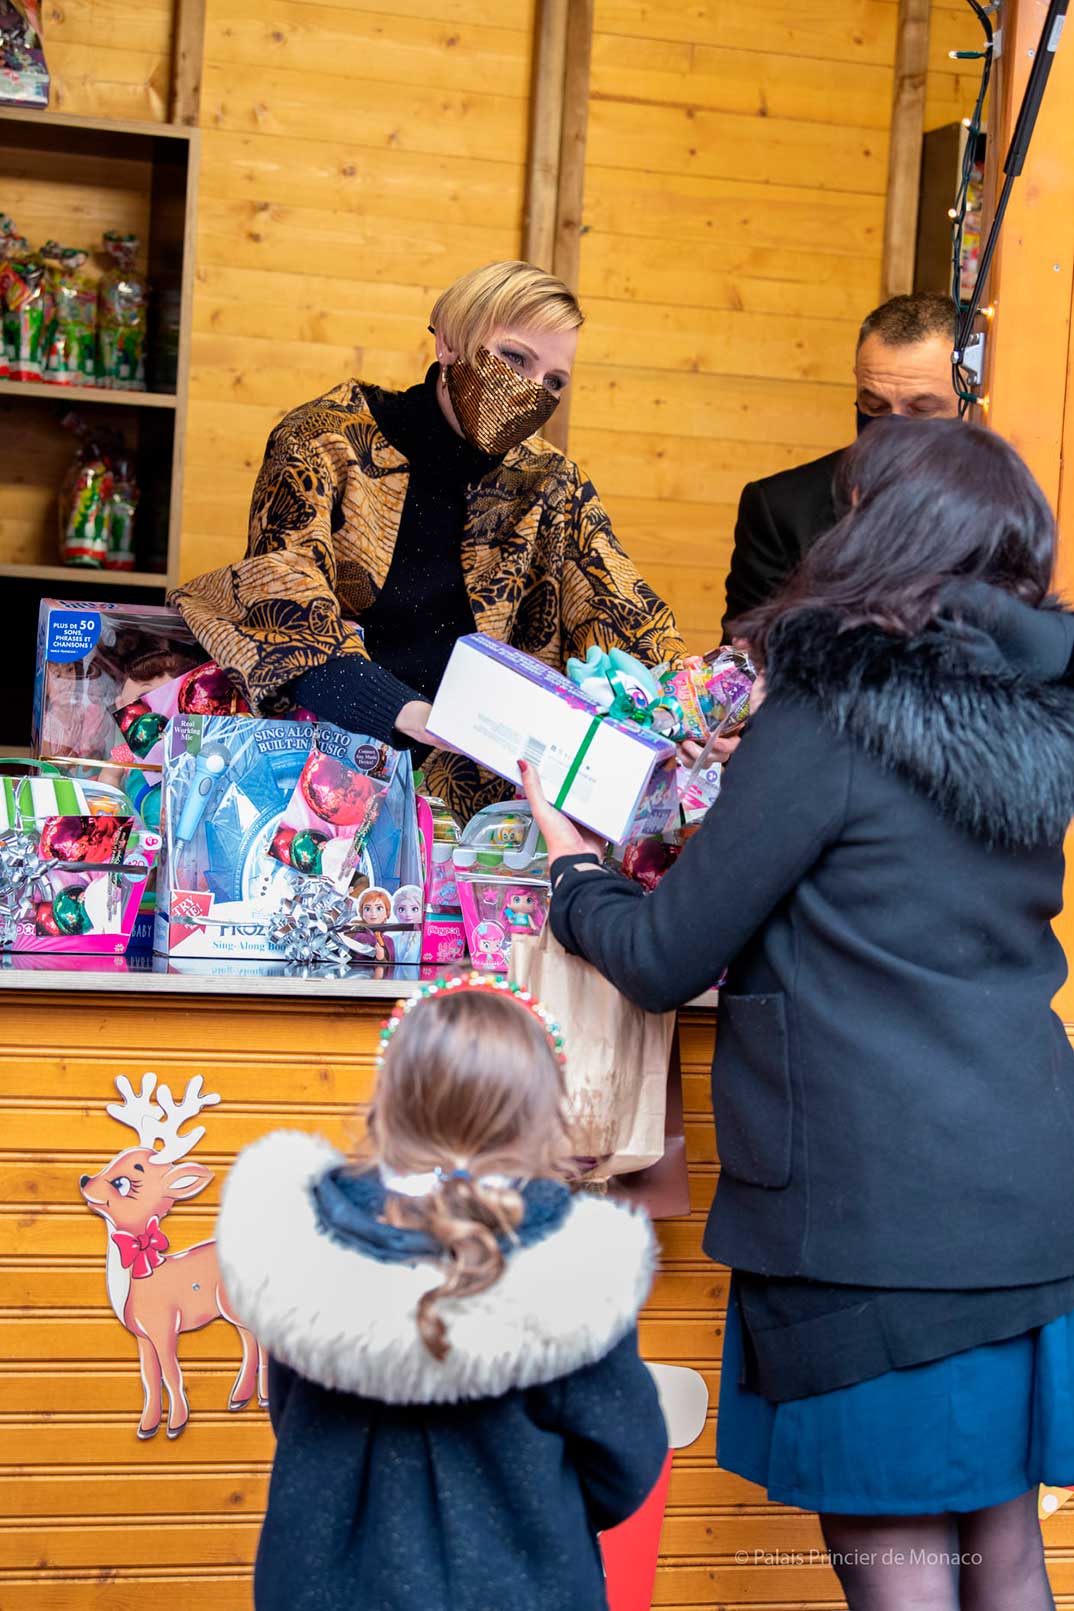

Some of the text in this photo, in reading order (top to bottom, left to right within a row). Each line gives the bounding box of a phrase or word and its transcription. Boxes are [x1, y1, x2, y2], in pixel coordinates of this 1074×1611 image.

[80, 620, 95, 630] 50
[174, 726, 201, 735] Working
[254, 727, 351, 746] SING ALOG TO
[258, 738, 347, 758] BUILT-IN USIC
[172, 896, 194, 916] TRY
[220, 925, 267, 936] FROZ
[213, 941, 265, 951] Sing-Along
